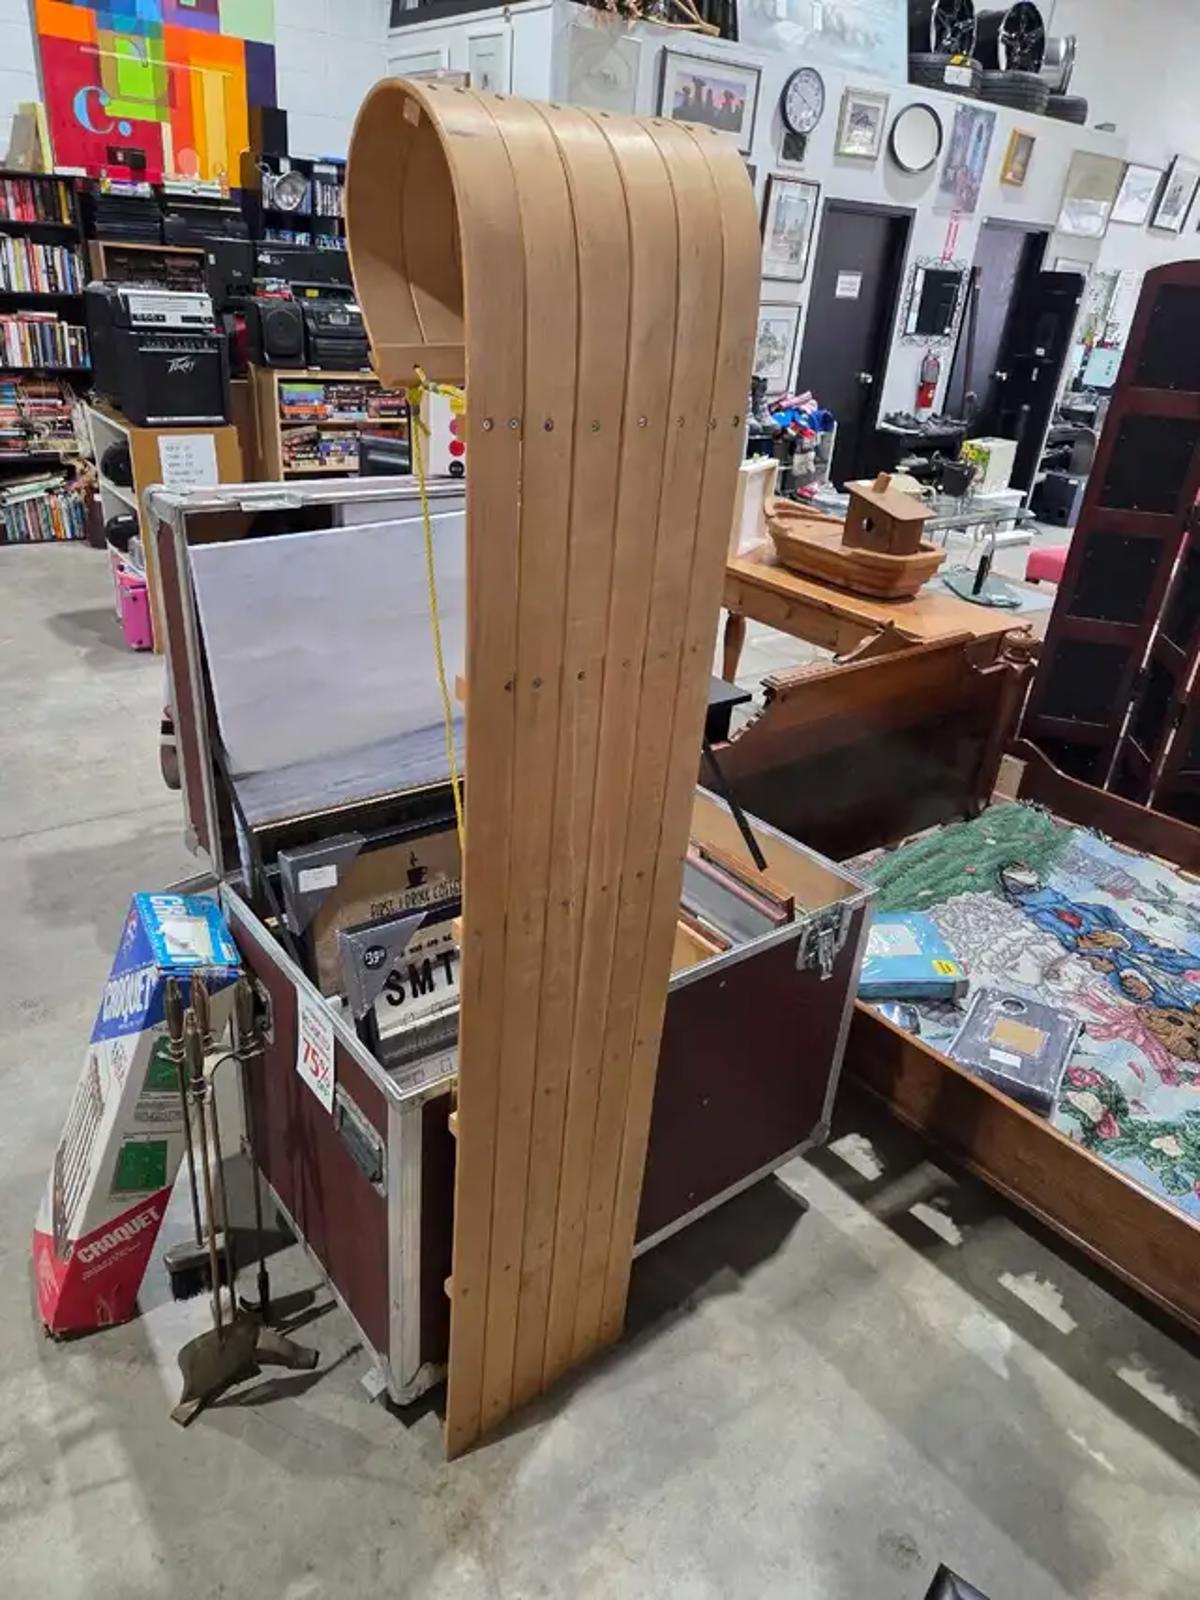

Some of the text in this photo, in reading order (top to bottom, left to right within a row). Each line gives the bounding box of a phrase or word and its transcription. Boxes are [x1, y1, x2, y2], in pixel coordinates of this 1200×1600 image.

[102, 967, 158, 1022] CROQUET
[303, 1037, 334, 1088] 75%
[77, 1205, 161, 1264] CROQUET
